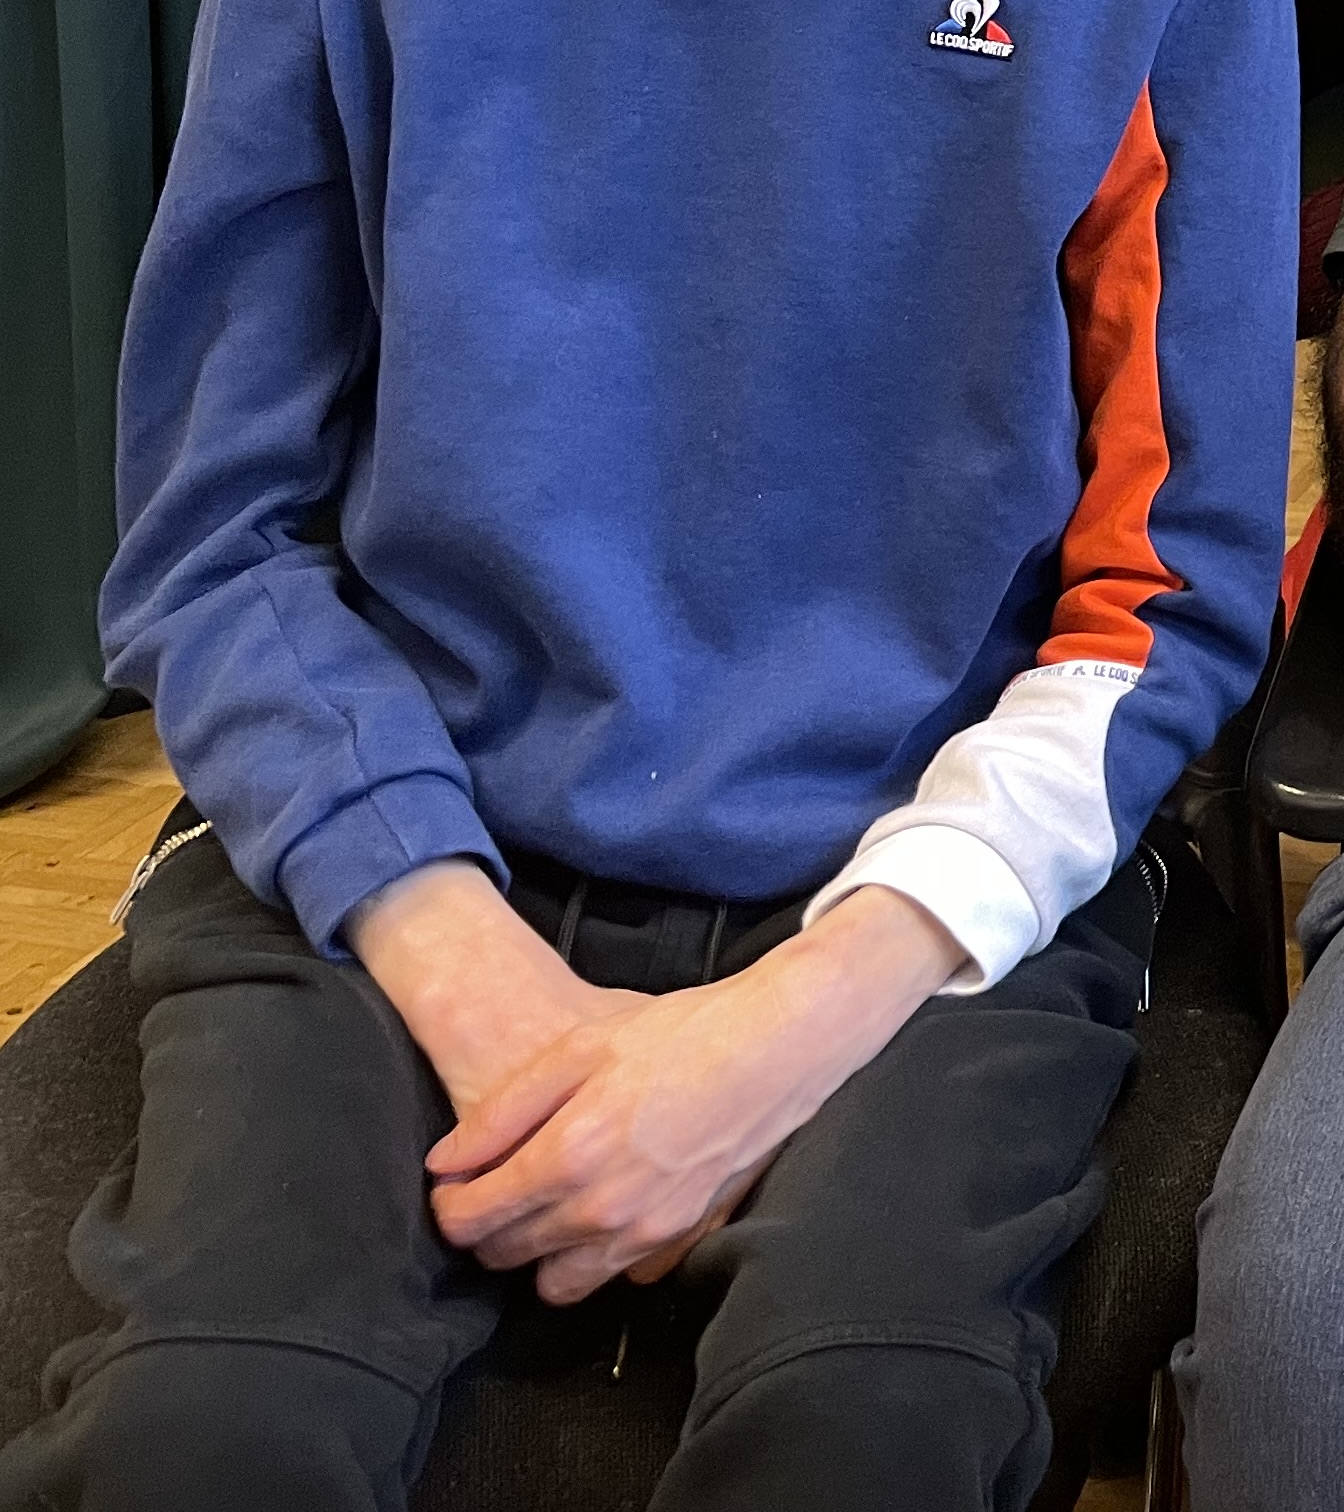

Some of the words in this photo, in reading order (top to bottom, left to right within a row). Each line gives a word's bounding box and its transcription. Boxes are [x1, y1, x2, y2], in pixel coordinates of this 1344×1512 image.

[930, 32, 944, 46] LE
[968, 37, 1014, 57] SPORTIF
[1094, 665, 1107, 677] LE
